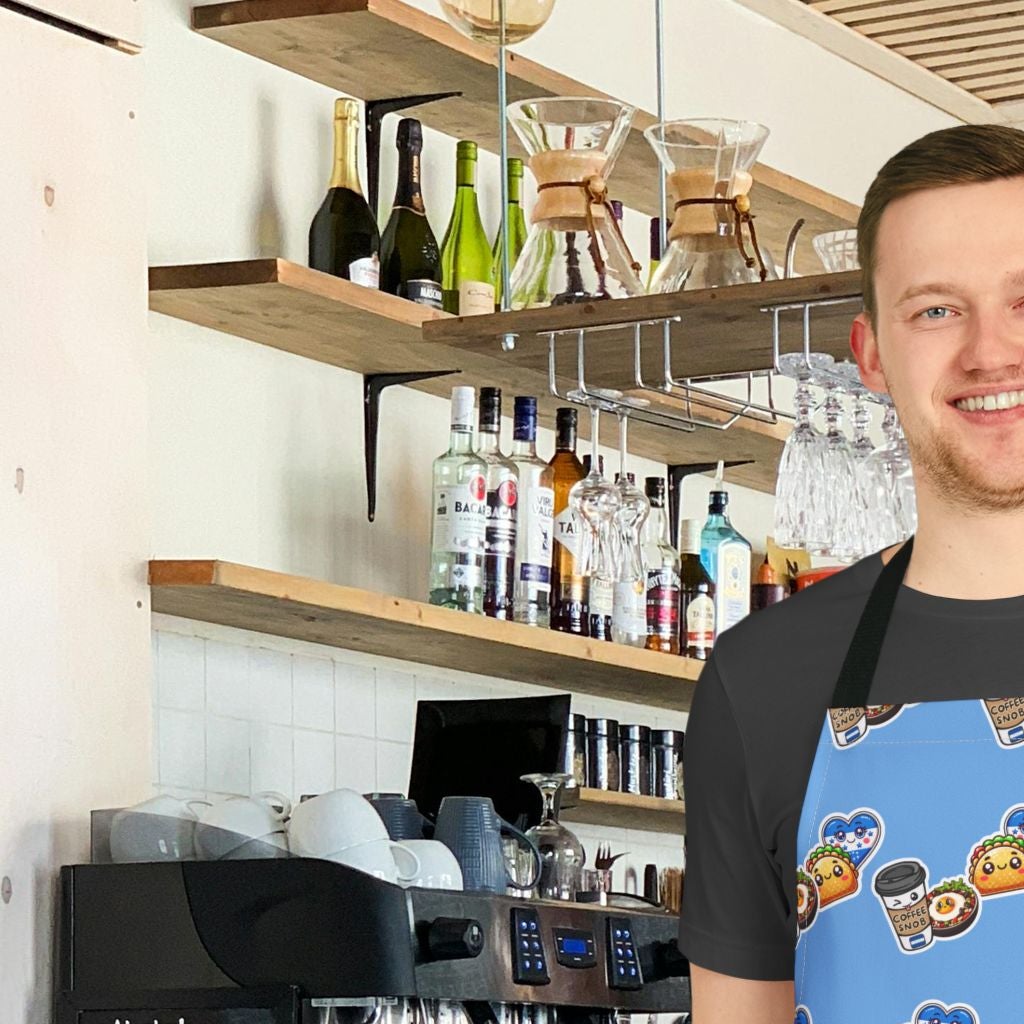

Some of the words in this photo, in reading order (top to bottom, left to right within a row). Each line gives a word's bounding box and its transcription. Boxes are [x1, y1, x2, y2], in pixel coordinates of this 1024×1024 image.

[991, 698, 1024, 715] COFFEE
[997, 707, 1024, 725] SNOB
[893, 905, 926, 922] COFFEE
[899, 918, 926, 931] SNOB
